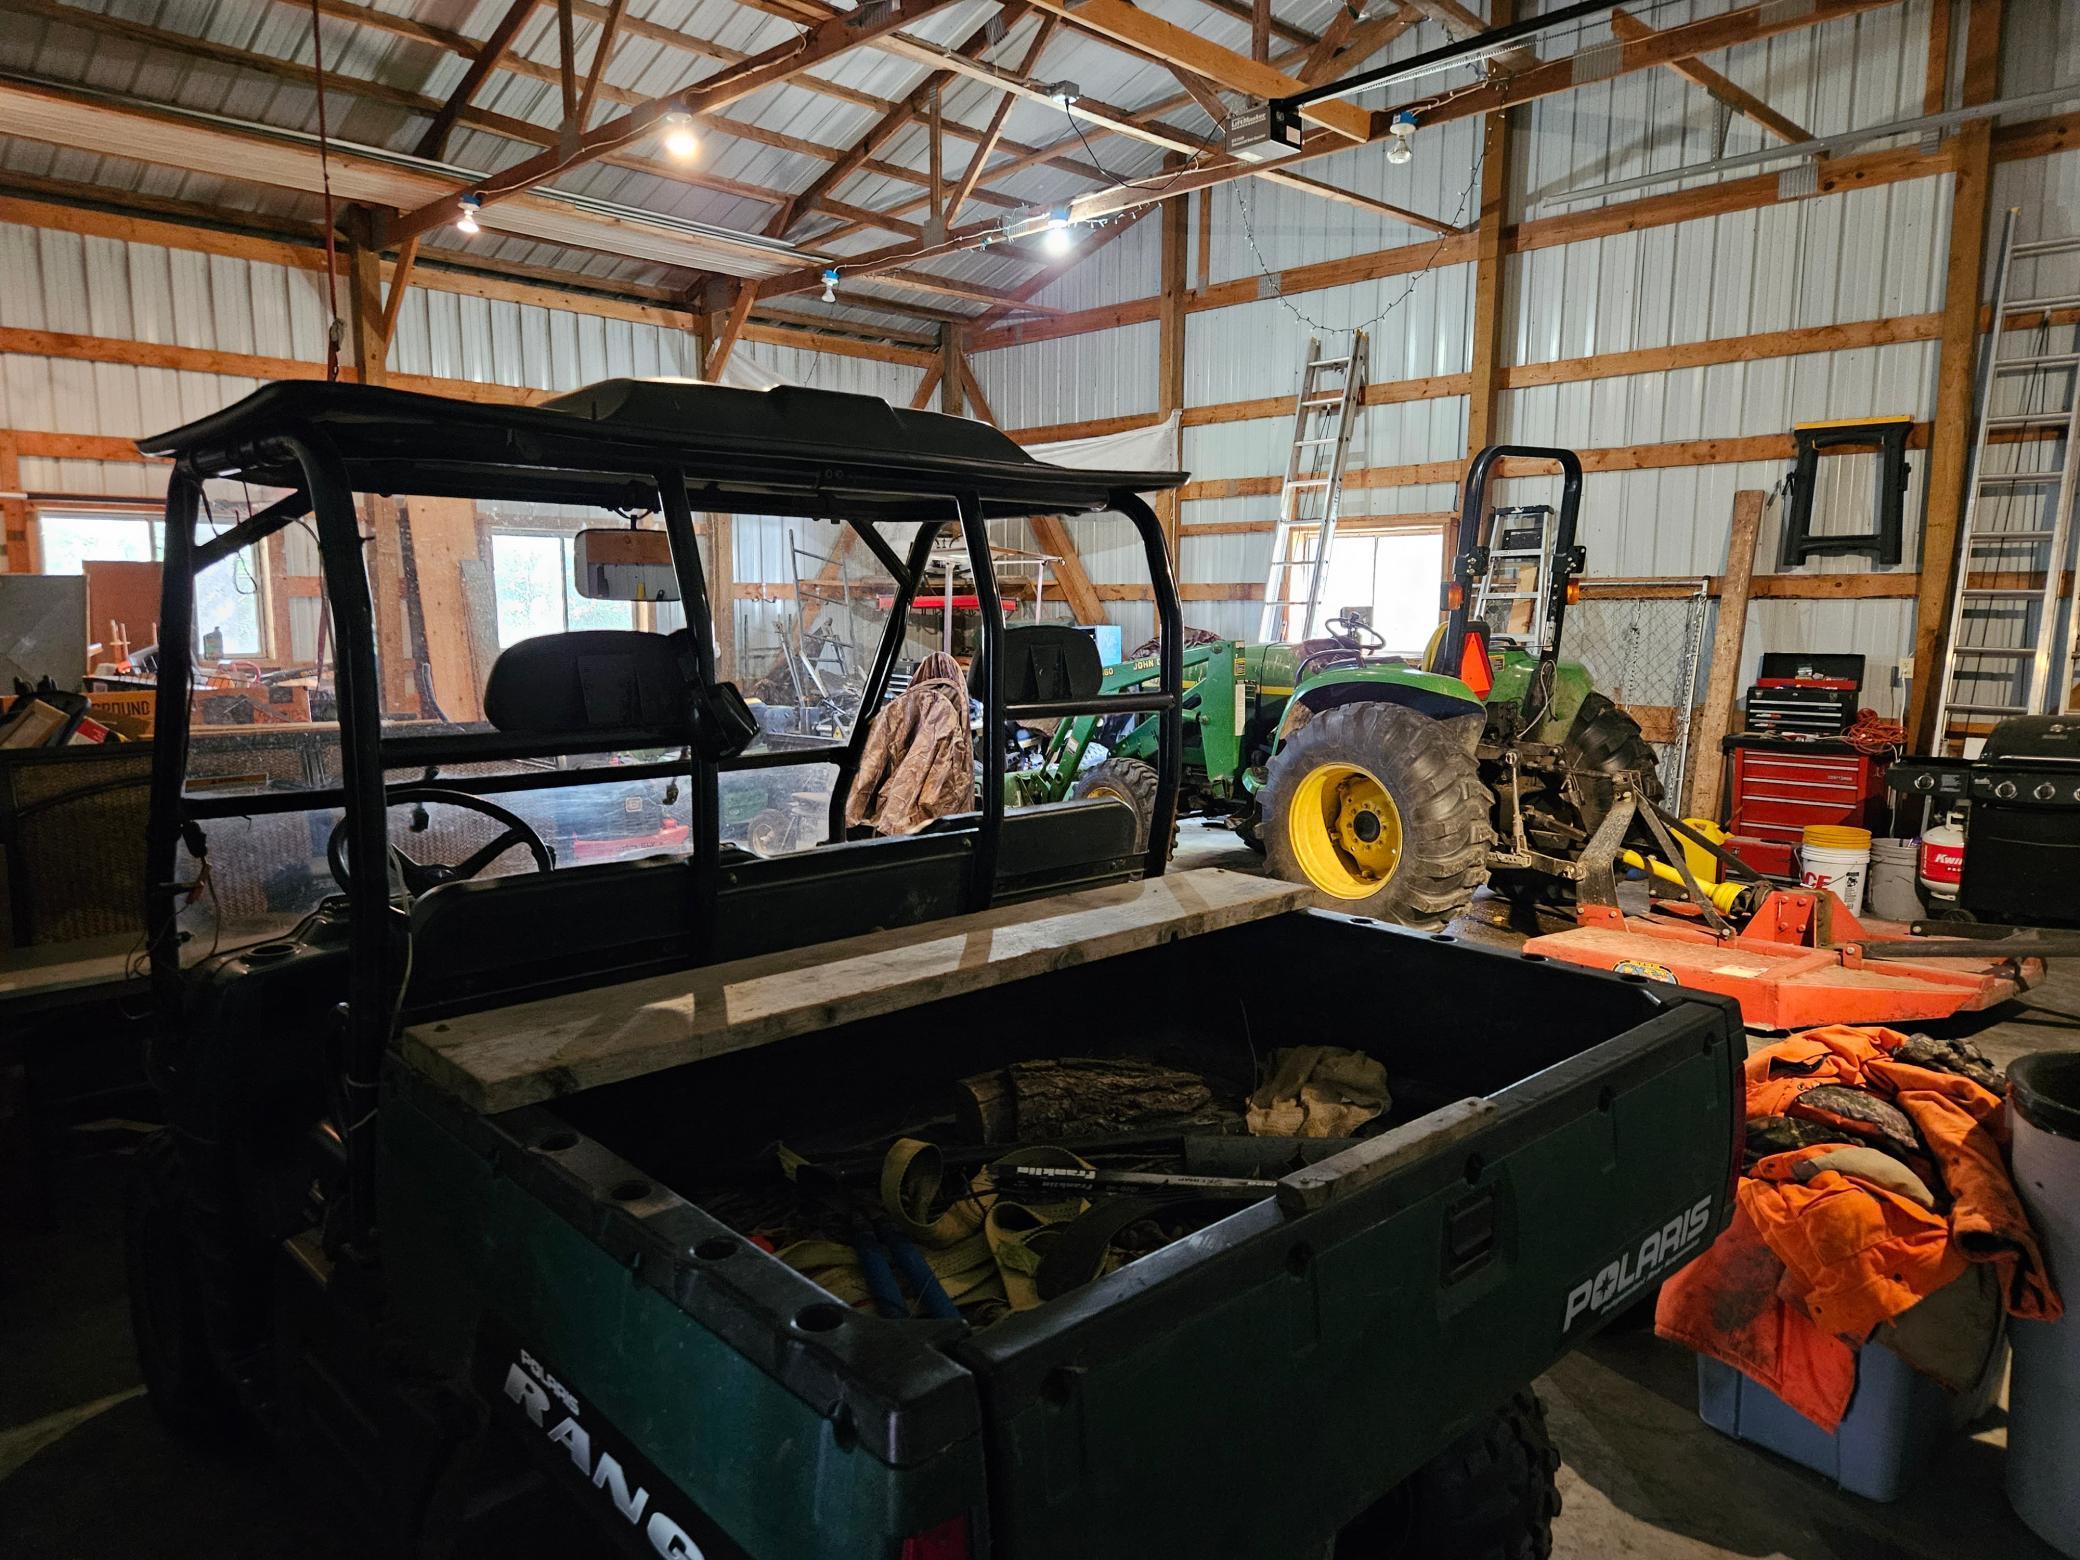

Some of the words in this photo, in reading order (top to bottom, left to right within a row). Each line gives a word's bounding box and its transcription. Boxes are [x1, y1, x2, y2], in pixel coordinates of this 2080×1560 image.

[1133, 659, 1154, 671] JOHN
[1016, 1166, 1096, 1180] Franklin
[1562, 1194, 1712, 1333] POLARIS
[520, 1348, 580, 1416] POLARIS
[503, 1362, 705, 1560] RANG
